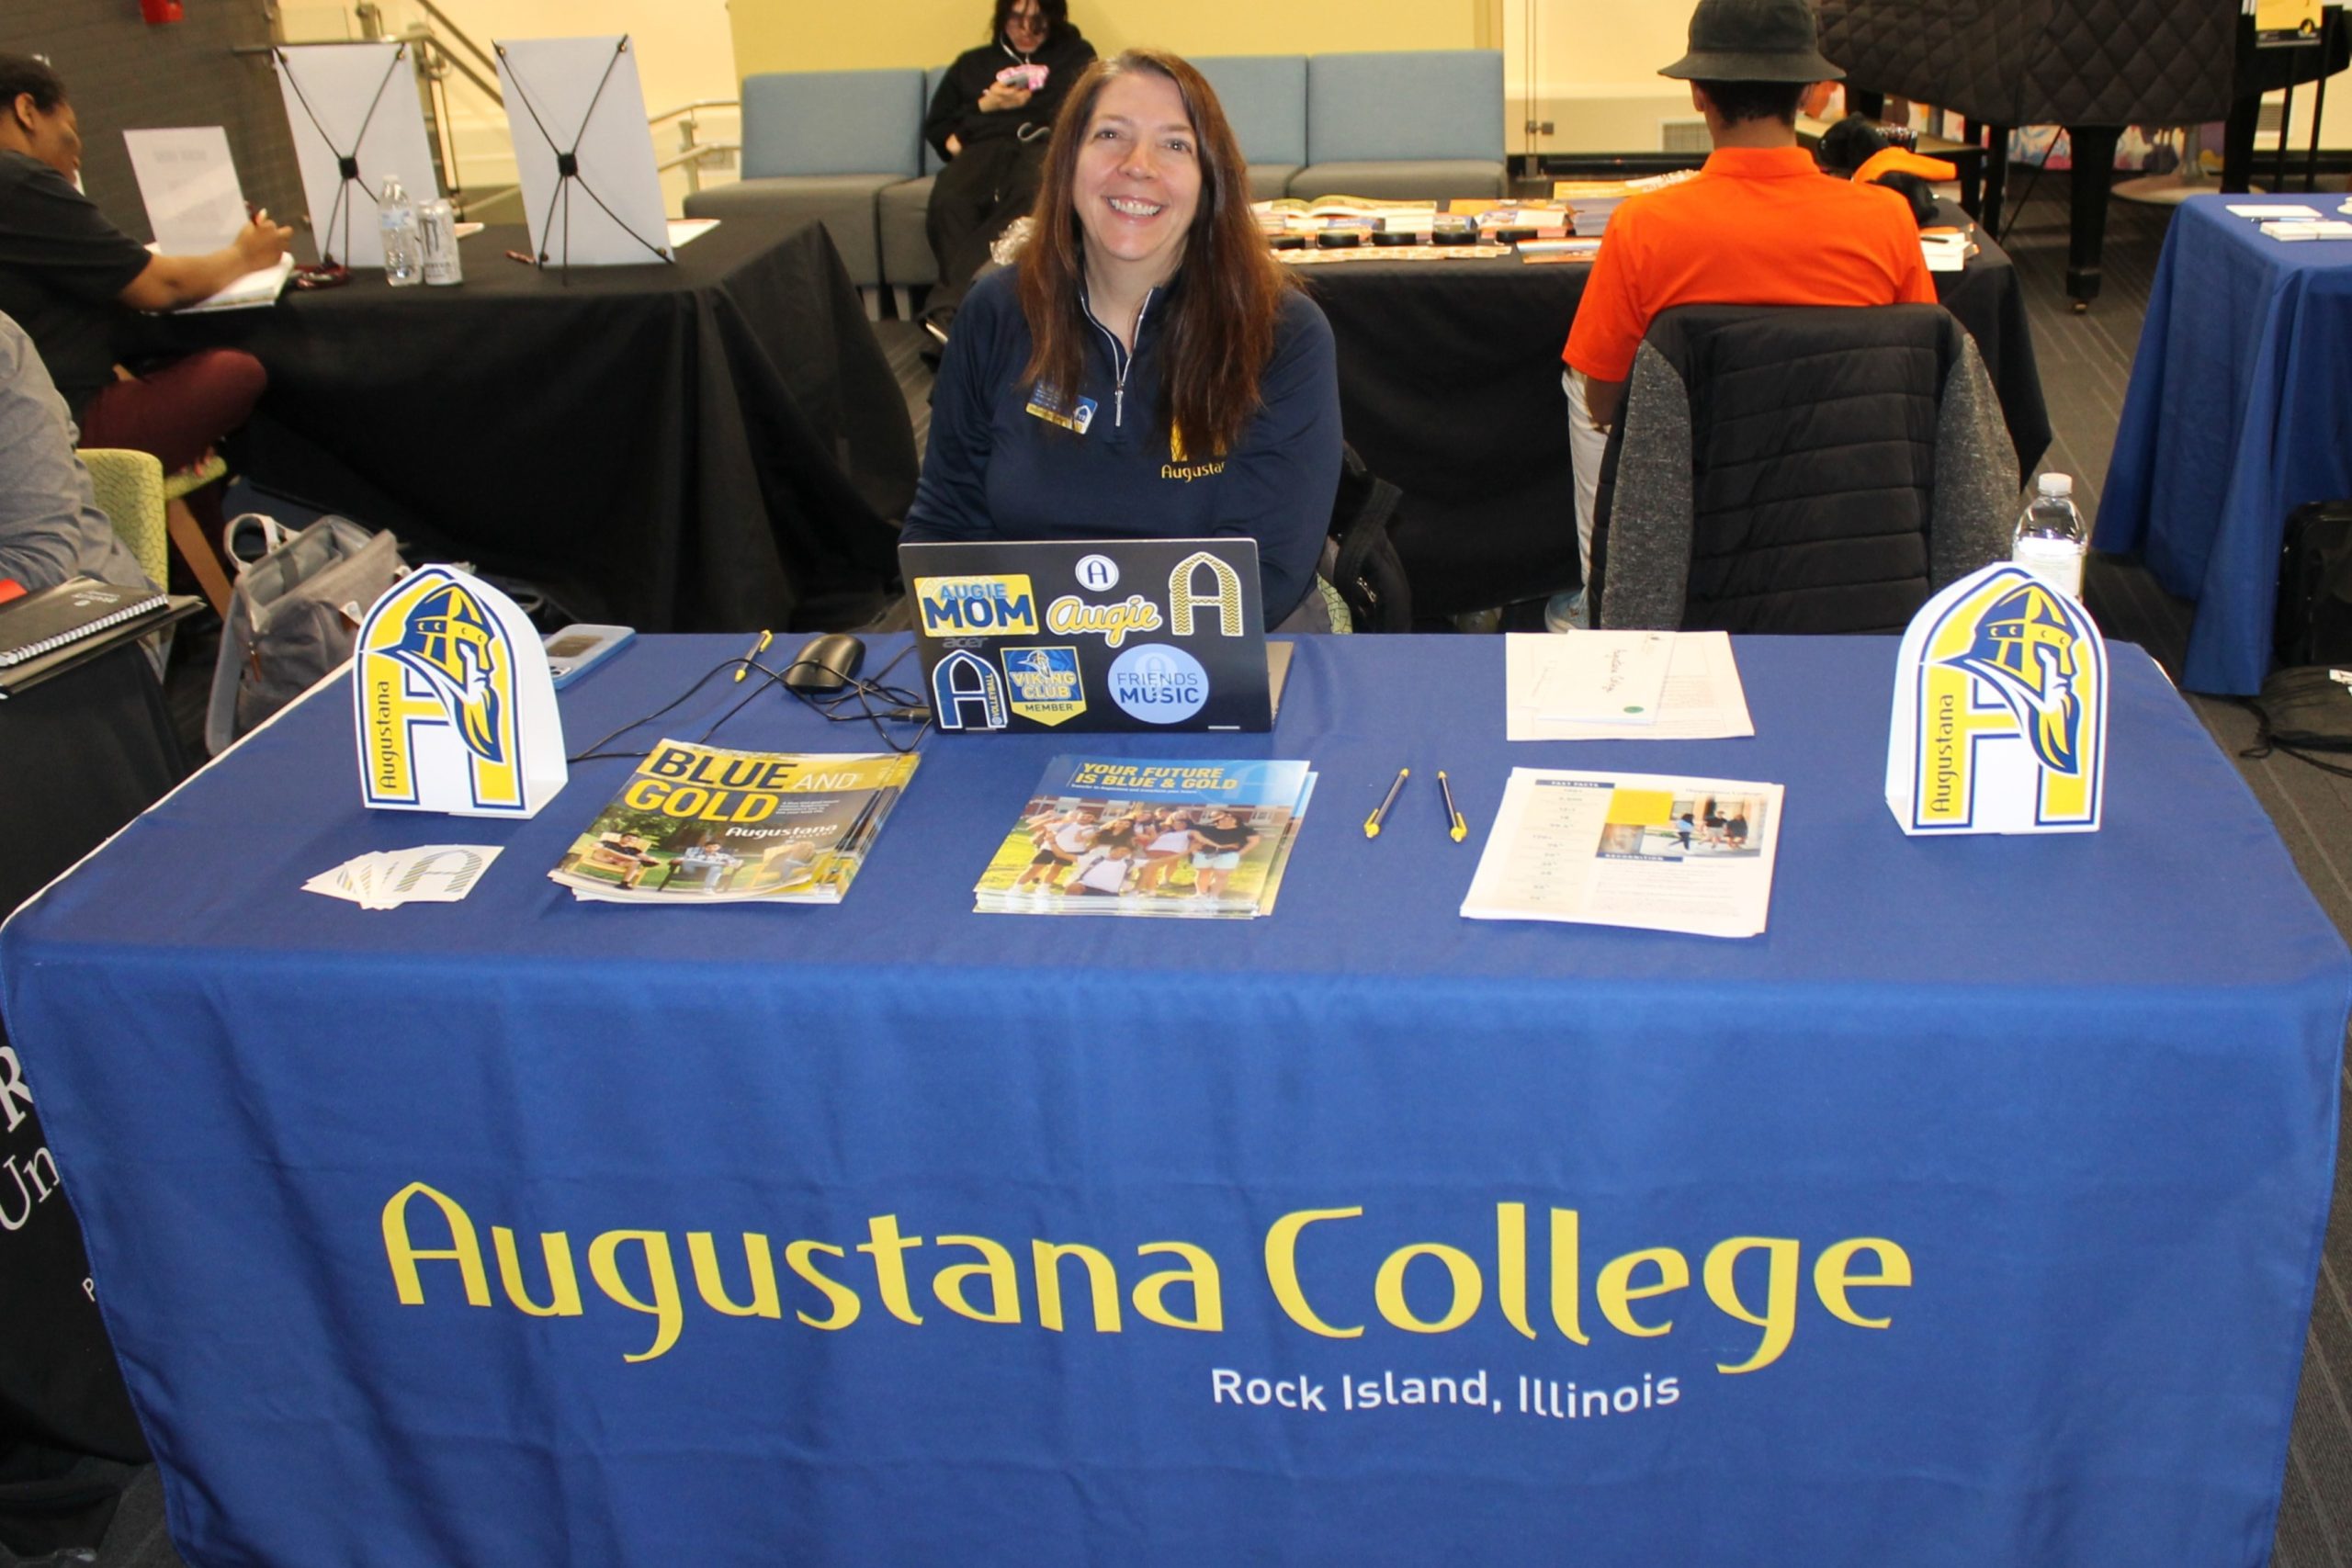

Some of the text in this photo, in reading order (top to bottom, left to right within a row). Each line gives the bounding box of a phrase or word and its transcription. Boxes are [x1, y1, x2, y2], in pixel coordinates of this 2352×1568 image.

[940, 583, 1007, 600] AUGIE
[922, 594, 1034, 628] MOM
[1048, 597, 1160, 646] Augie
[943, 637, 989, 649] acer
[1010, 671, 1077, 687] VIKING
[1117, 672, 1198, 686] FRIENDS
[985, 672, 1000, 718] VOLLEYBALL
[1022, 684, 1072, 700] CLUB
[1119, 687, 1199, 704] MUSIC
[1025, 704, 1073, 713] MEMBER
[377, 680, 401, 790] Augustana
[1929, 693, 1960, 813] Augustana
[650, 748, 857, 791] BLUE AND
[1082, 762, 1225, 779] YOUR FUTURE
[1075, 773, 1099, 784] IS
[1101, 774, 1155, 788] BLUE
[1160, 778, 1176, 789] &
[1182, 778, 1238, 790] GOLD
[625, 779, 779, 822] GOLD
[725, 825, 838, 840] Augustana
[381, 1181, 1912, 1374] Augustana College
[1212, 1368, 1680, 1419] Rock Island, Illinois
